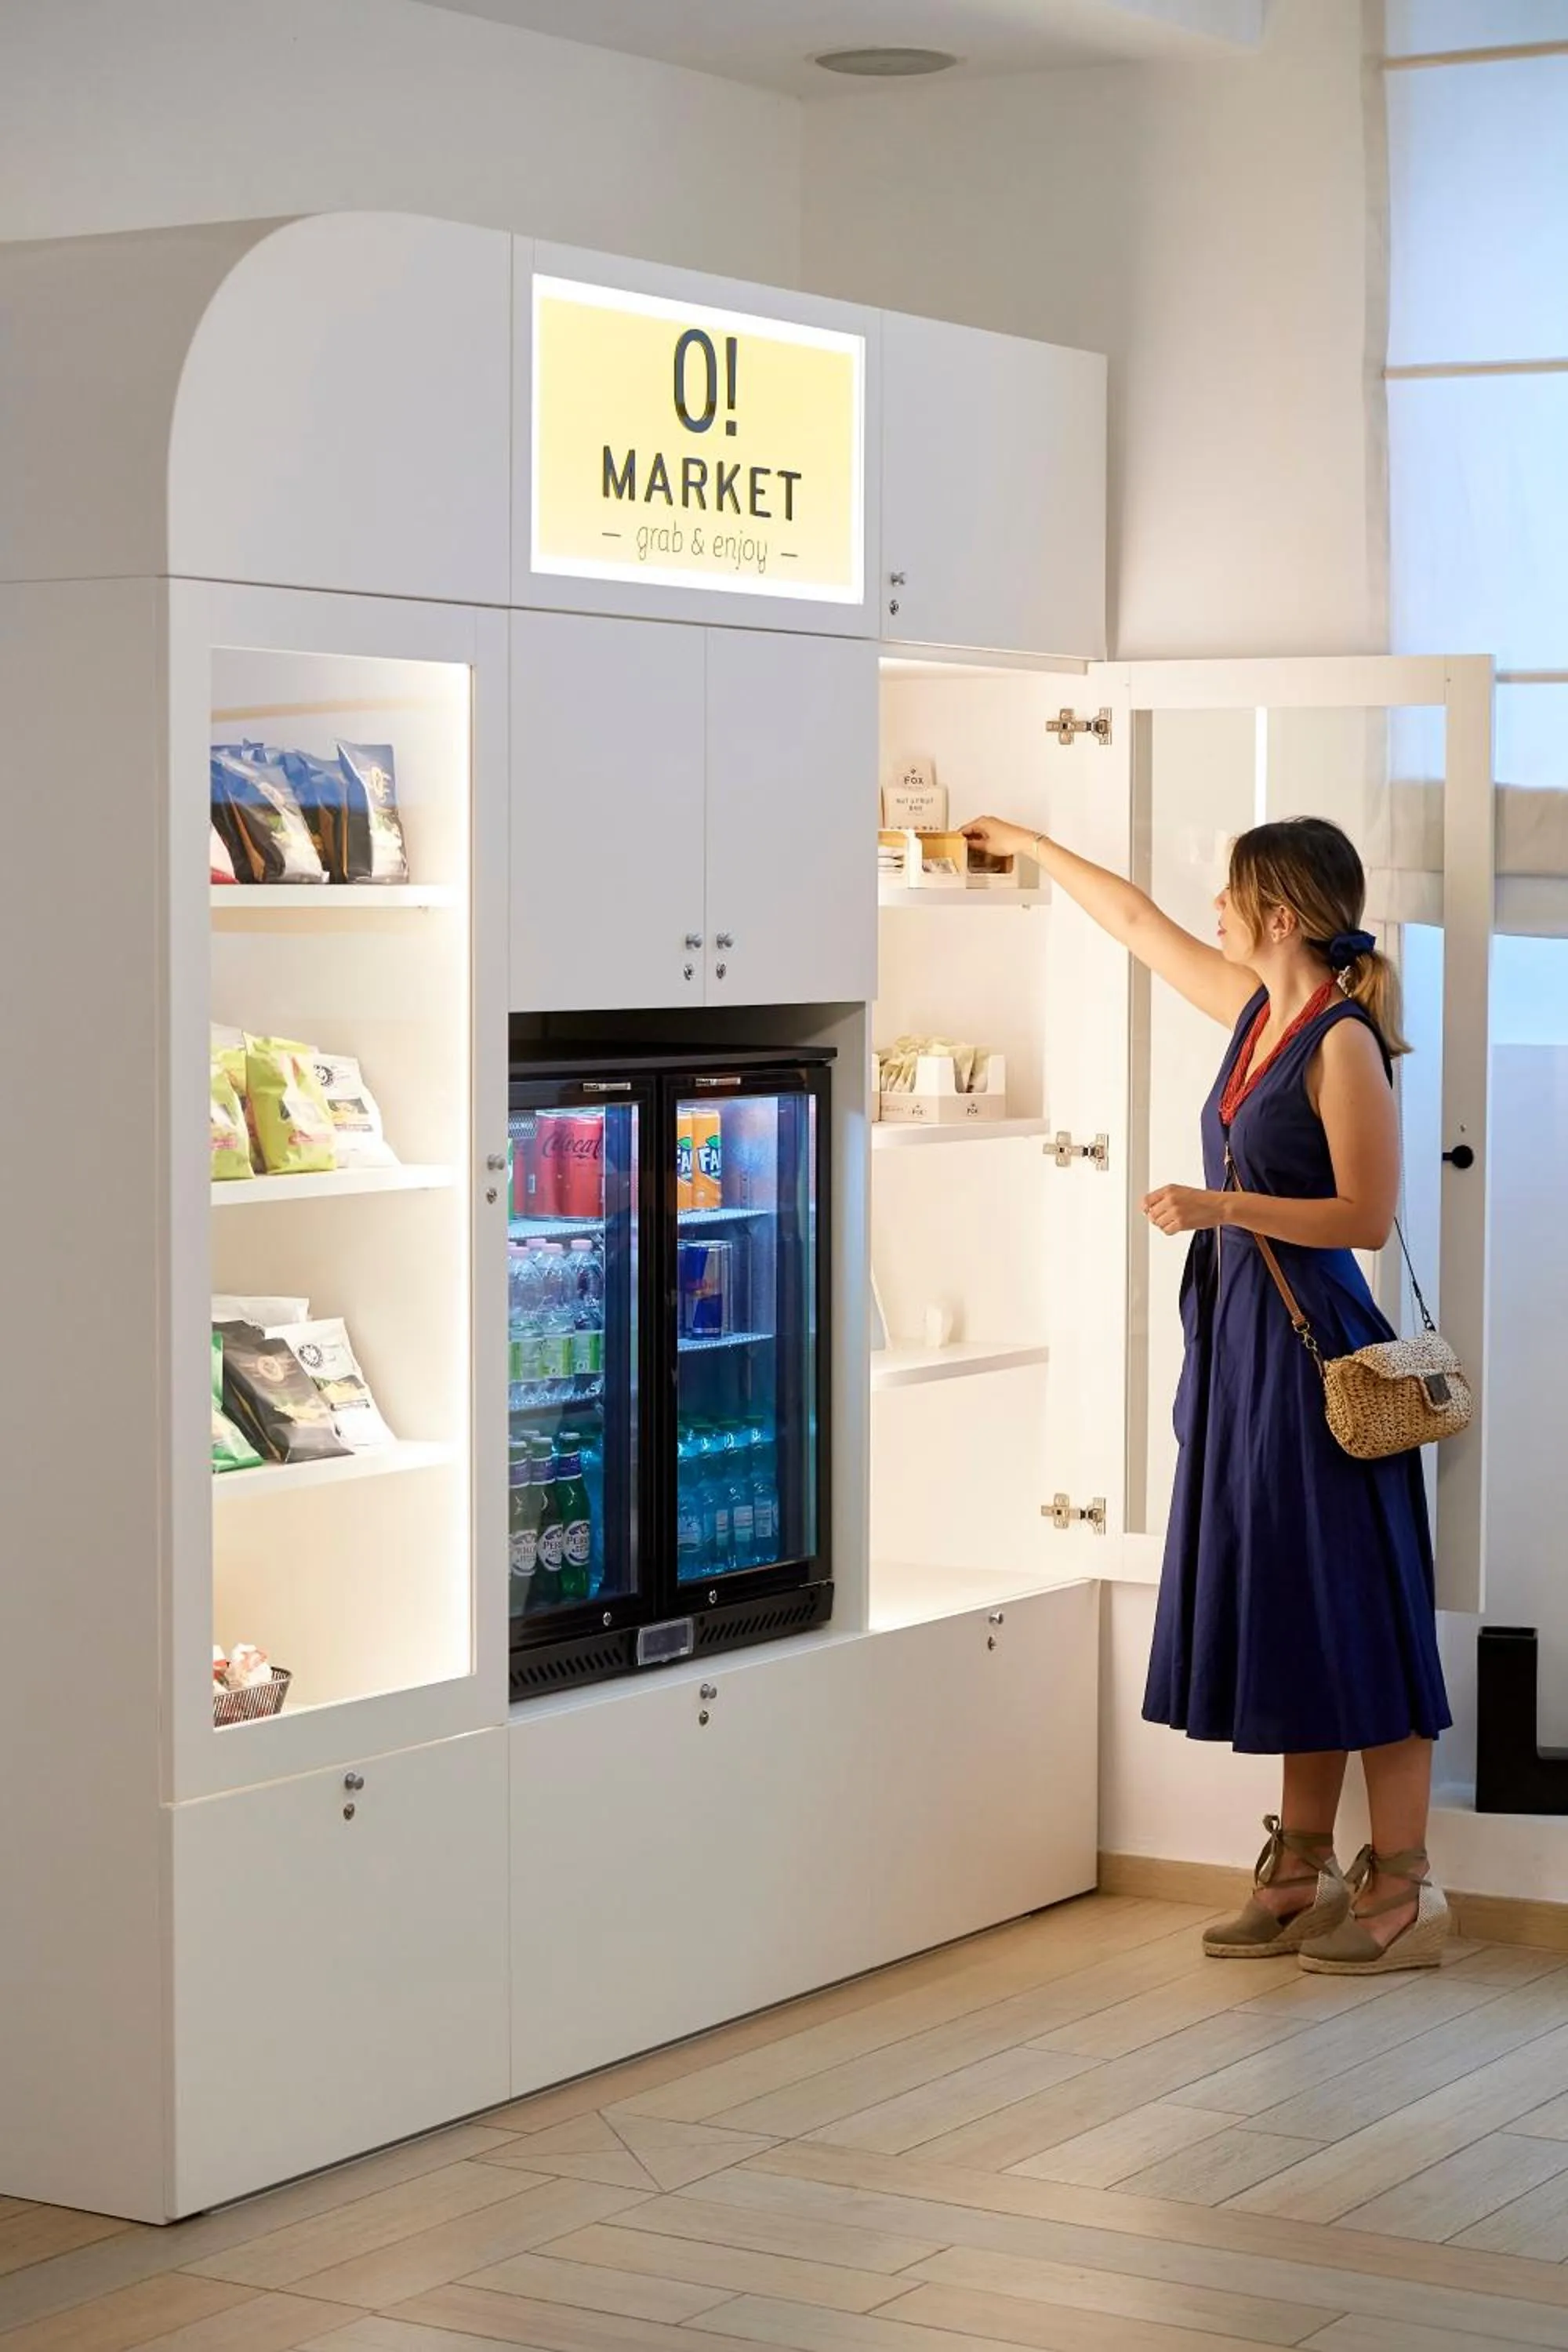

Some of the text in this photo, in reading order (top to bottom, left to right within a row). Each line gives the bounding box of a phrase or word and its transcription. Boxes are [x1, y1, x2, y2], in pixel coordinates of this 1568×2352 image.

[673, 328, 738, 437] O!
[601, 445, 802, 521] MARKET
[636, 521, 768, 573] grab & enjoy
